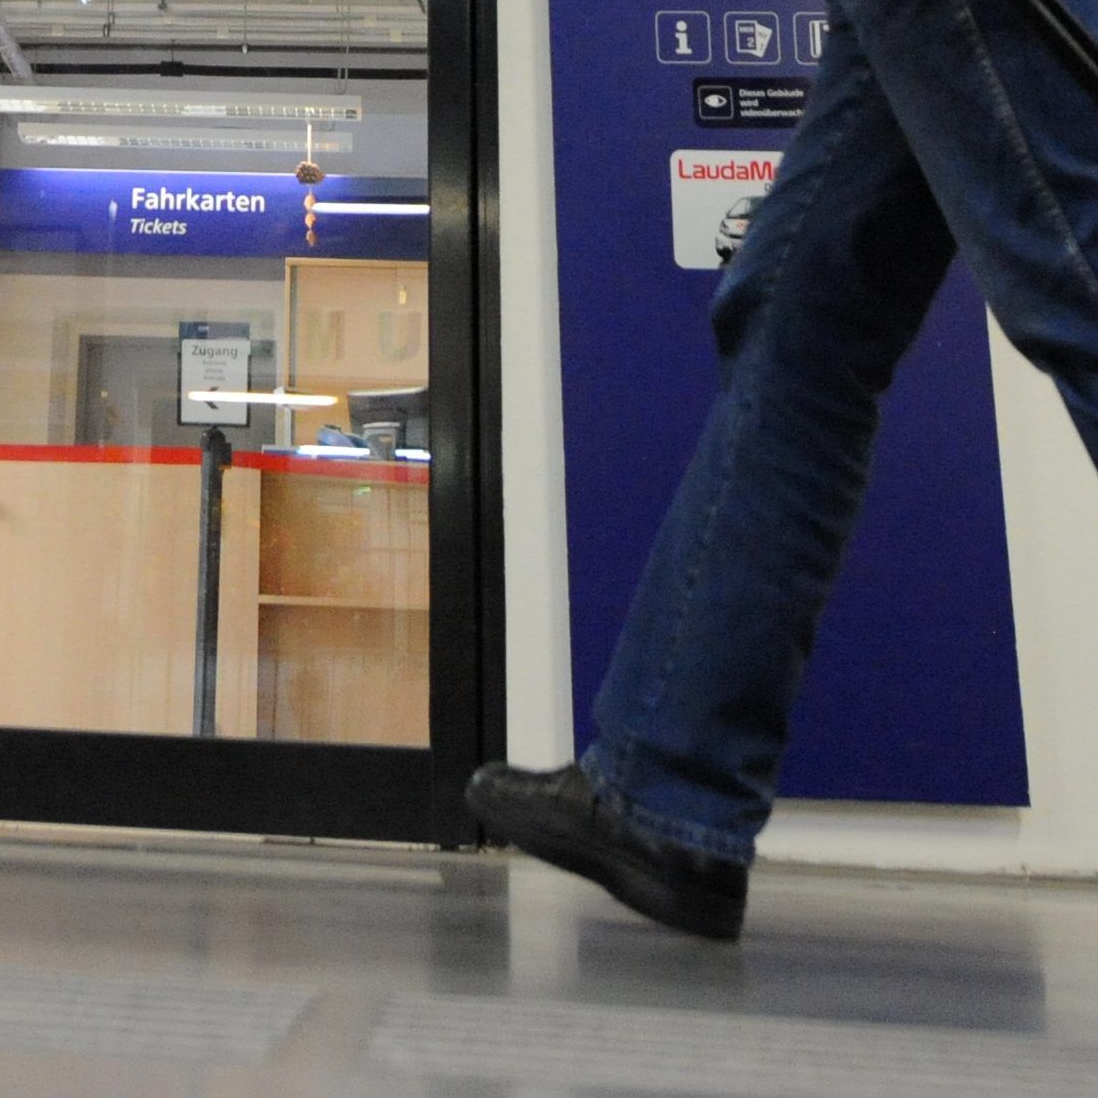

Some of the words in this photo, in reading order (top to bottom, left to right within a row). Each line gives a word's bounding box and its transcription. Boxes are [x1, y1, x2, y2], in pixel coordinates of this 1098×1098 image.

[740, 108, 804, 118] videoüberwach
[130, 186, 266, 214] Fahrkarten
[129, 217, 188, 236] Tickets
[191, 344, 238, 359] Zugang
